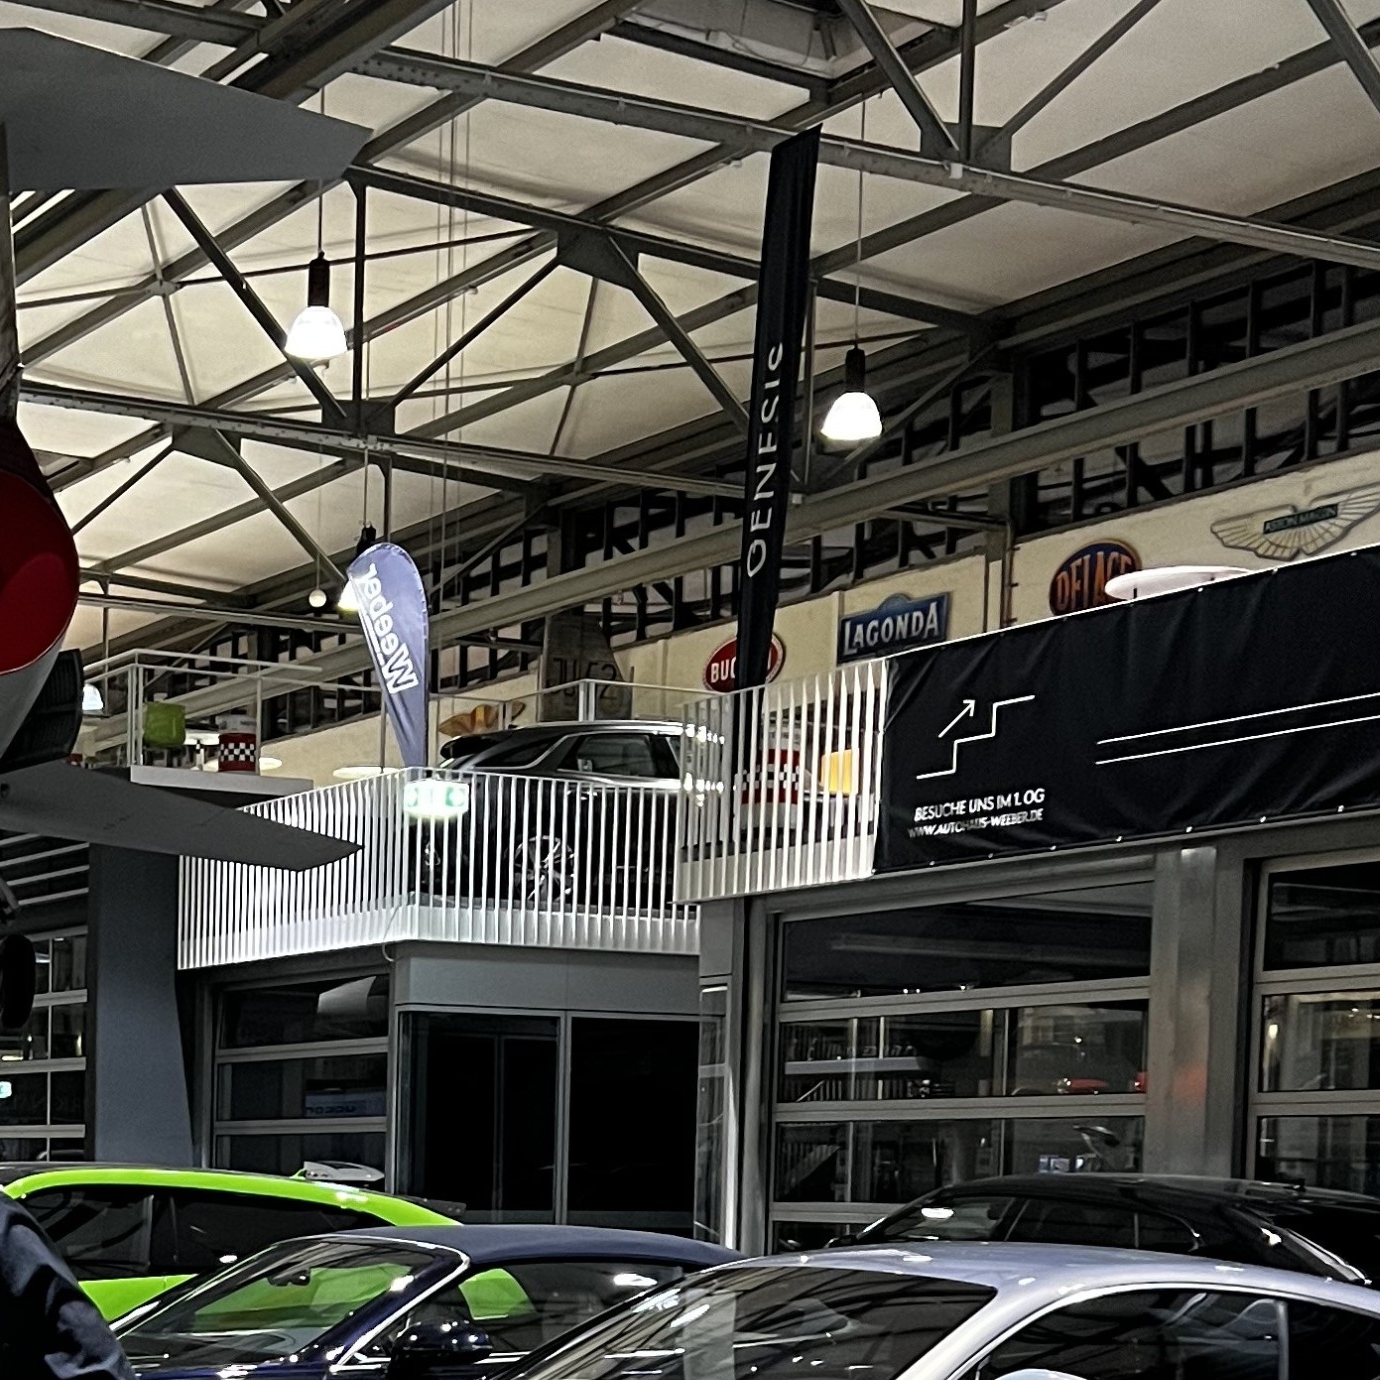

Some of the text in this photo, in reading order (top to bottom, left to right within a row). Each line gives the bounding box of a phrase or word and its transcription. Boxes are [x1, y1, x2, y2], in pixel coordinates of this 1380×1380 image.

[746, 340, 785, 579] GENESIS
[842, 601, 940, 655] LAGONDA
[914, 800, 967, 822] BESUCHE
[969, 796, 995, 813] UNS
[996, 793, 1012, 810] IM
